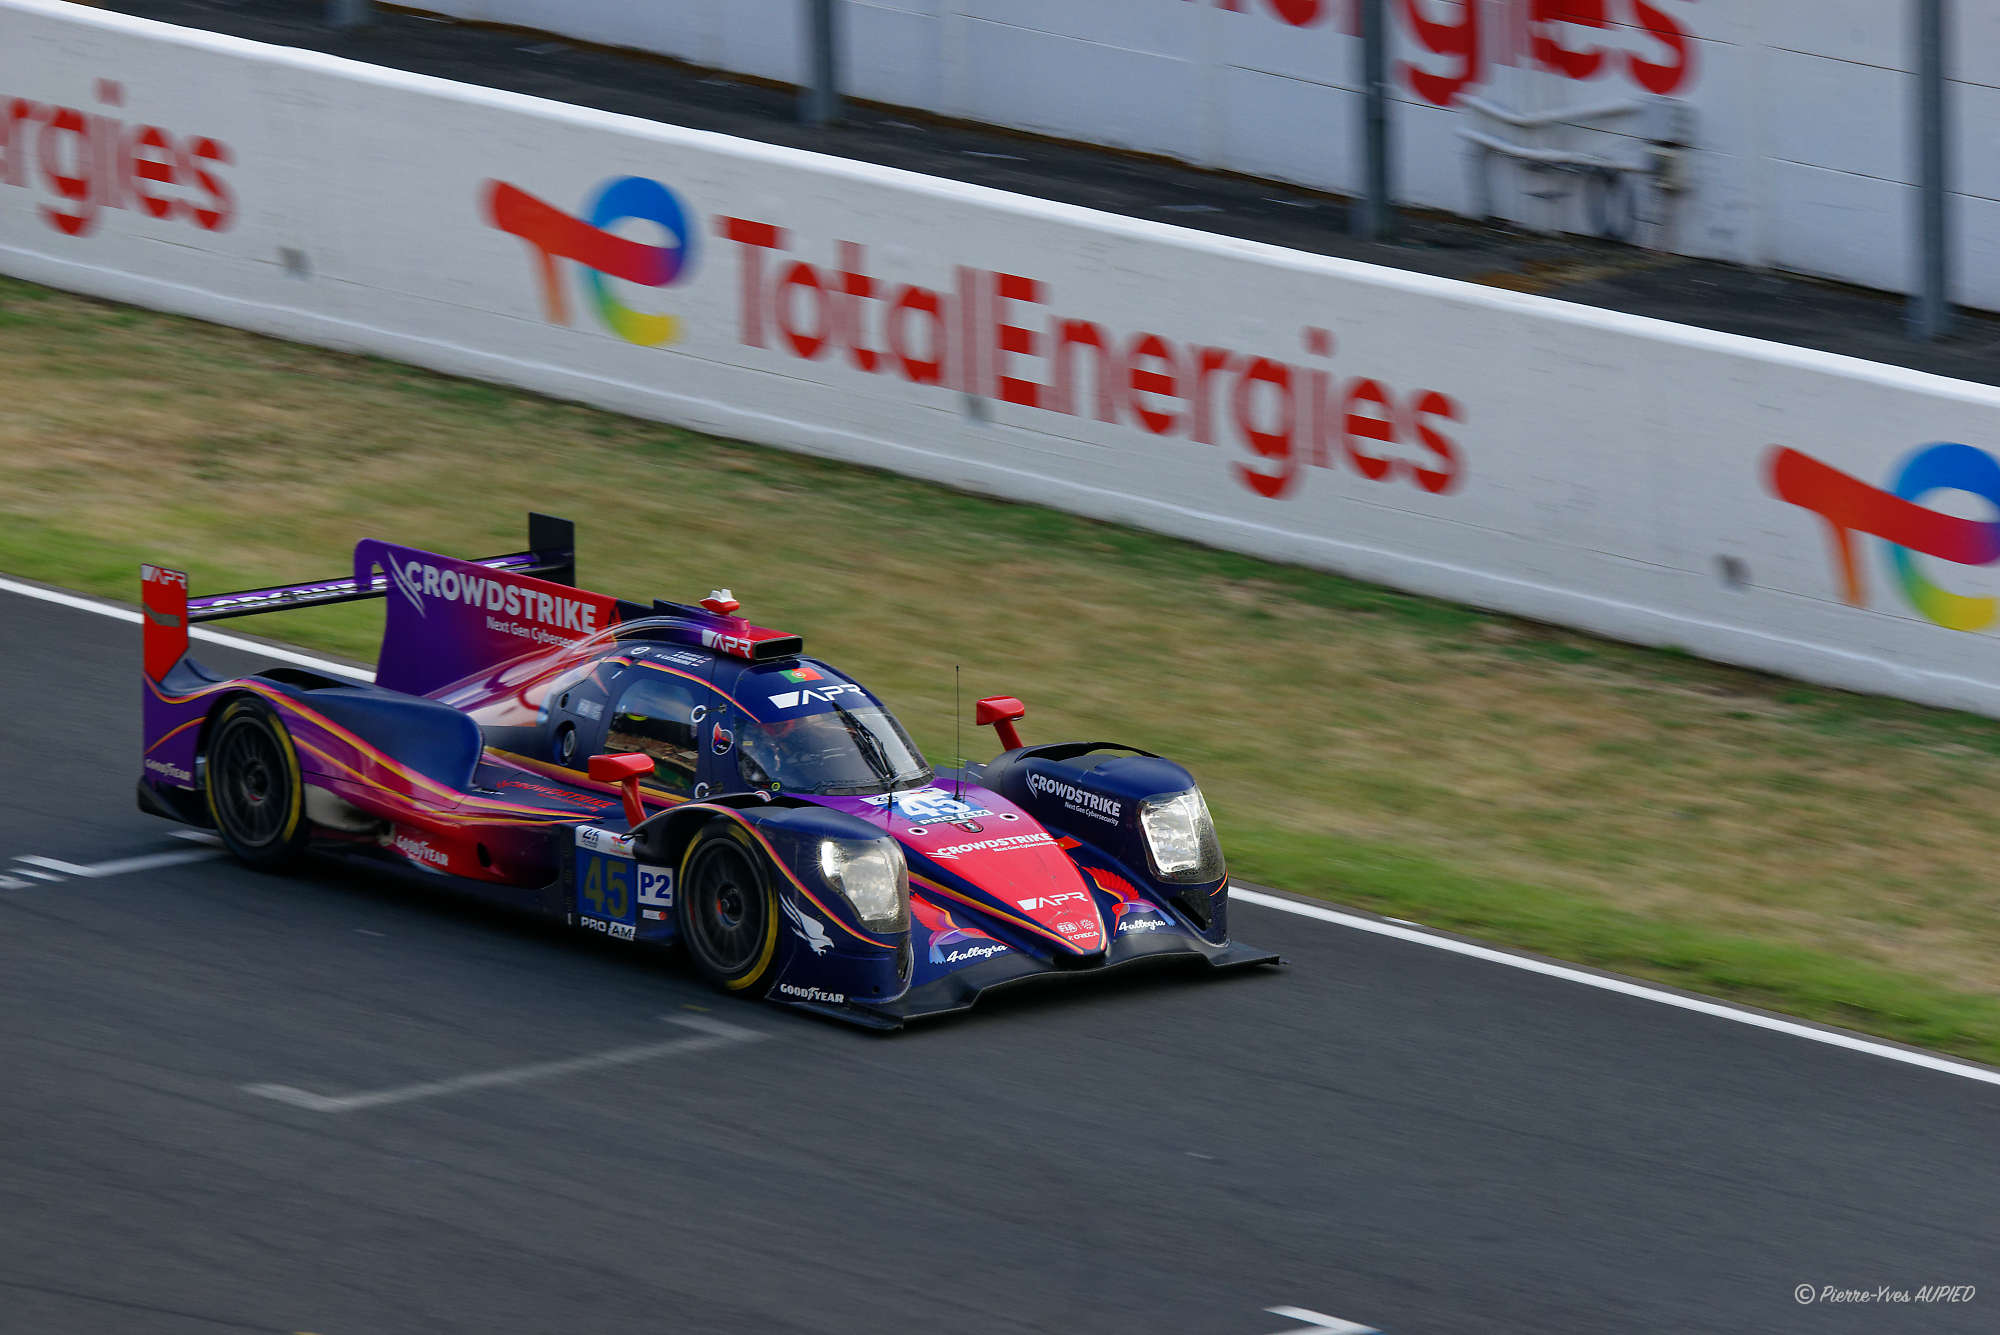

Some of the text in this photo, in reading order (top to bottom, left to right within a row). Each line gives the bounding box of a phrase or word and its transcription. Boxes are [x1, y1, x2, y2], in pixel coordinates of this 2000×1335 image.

[714, 215, 1466, 499] TotalEnergies
[404, 561, 597, 635] CROWDSTRIKE
[486, 615, 509, 633] Next
[510, 622, 530, 639] Gen
[712, 633, 751, 659] APR
[802, 684, 867, 705] APR
[900, 796, 972, 818] 45
[1031, 773, 1121, 818] CROWDSTRIKE
[936, 832, 1055, 859] CROWDSTRIKE
[584, 856, 628, 919] 45
[640, 871, 671, 900] P2
[1038, 891, 1089, 909] APR
[580, 916, 636, 940] PRO AM
[780, 983, 845, 1003] GOODYEAR
